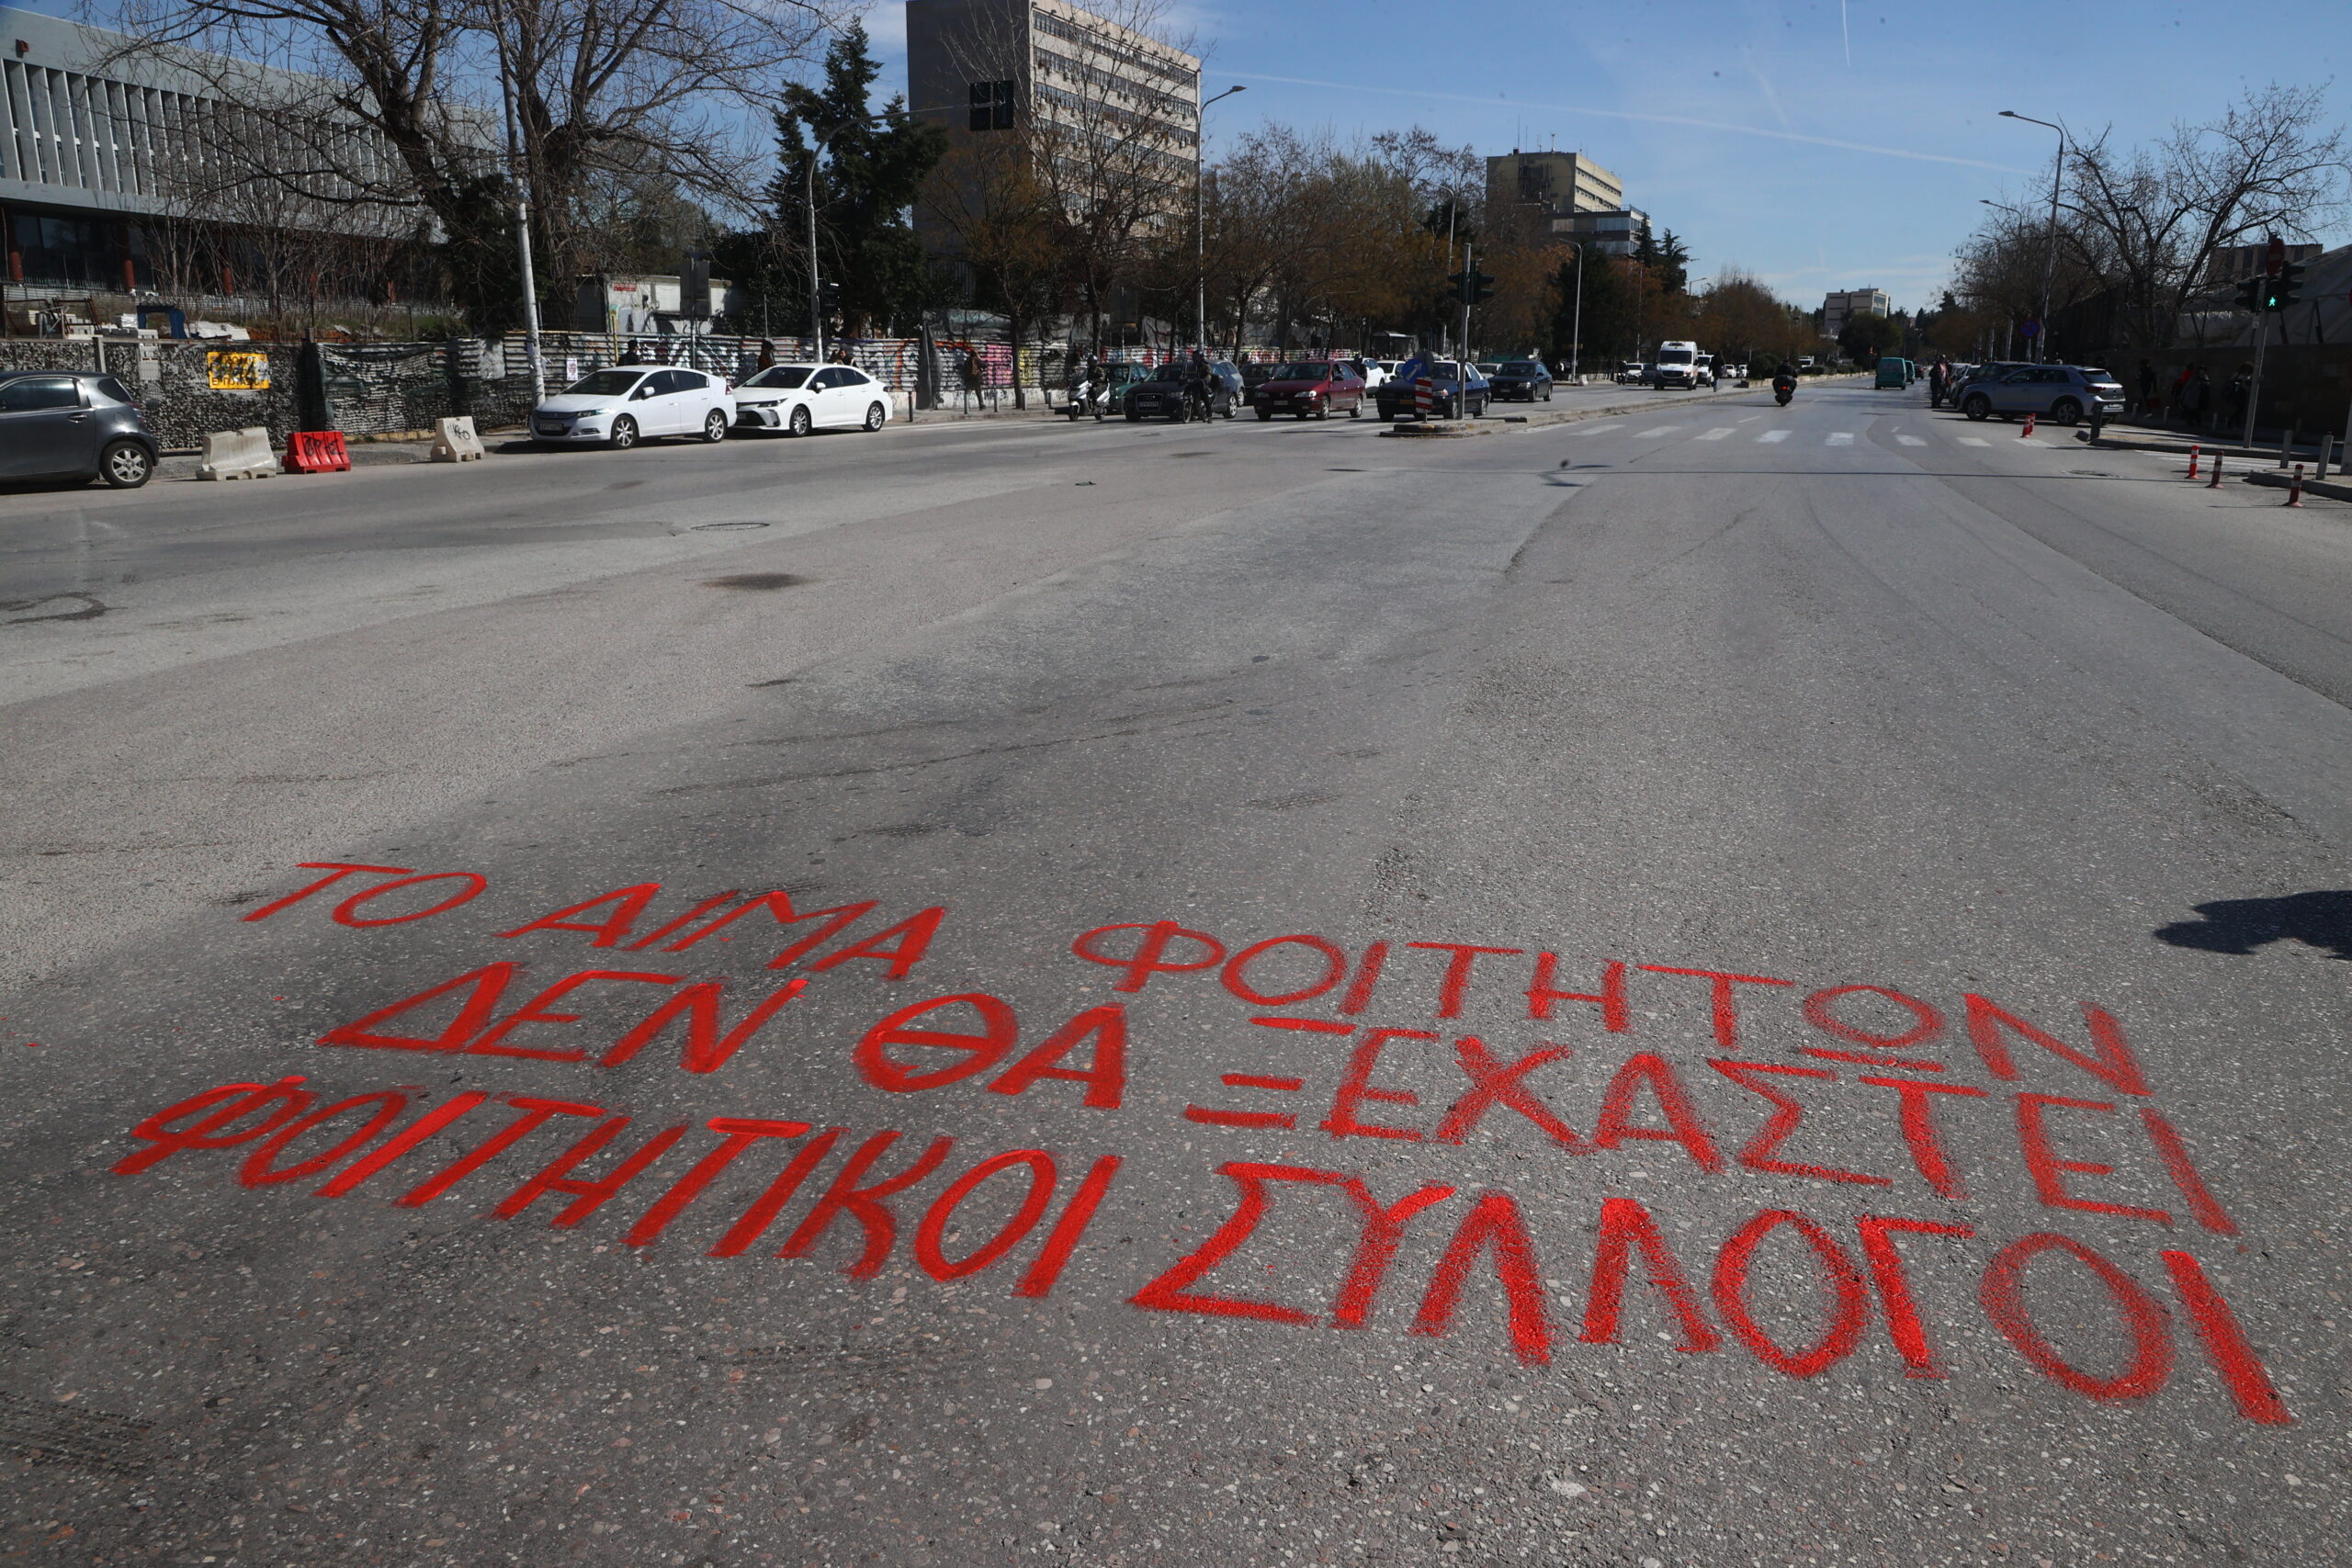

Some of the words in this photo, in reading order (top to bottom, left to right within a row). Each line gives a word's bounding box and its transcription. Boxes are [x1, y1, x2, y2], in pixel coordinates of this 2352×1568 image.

[240, 862, 487, 928] ΤΟ
[495, 883, 945, 981] ΑΙΜΑ
[315, 962, 809, 1075] ΔΕΝ
[852, 993, 1128, 1111] ΘΑ
[1183, 1016, 2236, 1236] ΞΕΧΑΣΤΕΙ
[109, 1076, 1123, 1299] ΦΟΙΤΗΤΙΚΟΙ
[1125, 1161, 2291, 1427] ΣΥΛΛΟΓΟΙ
